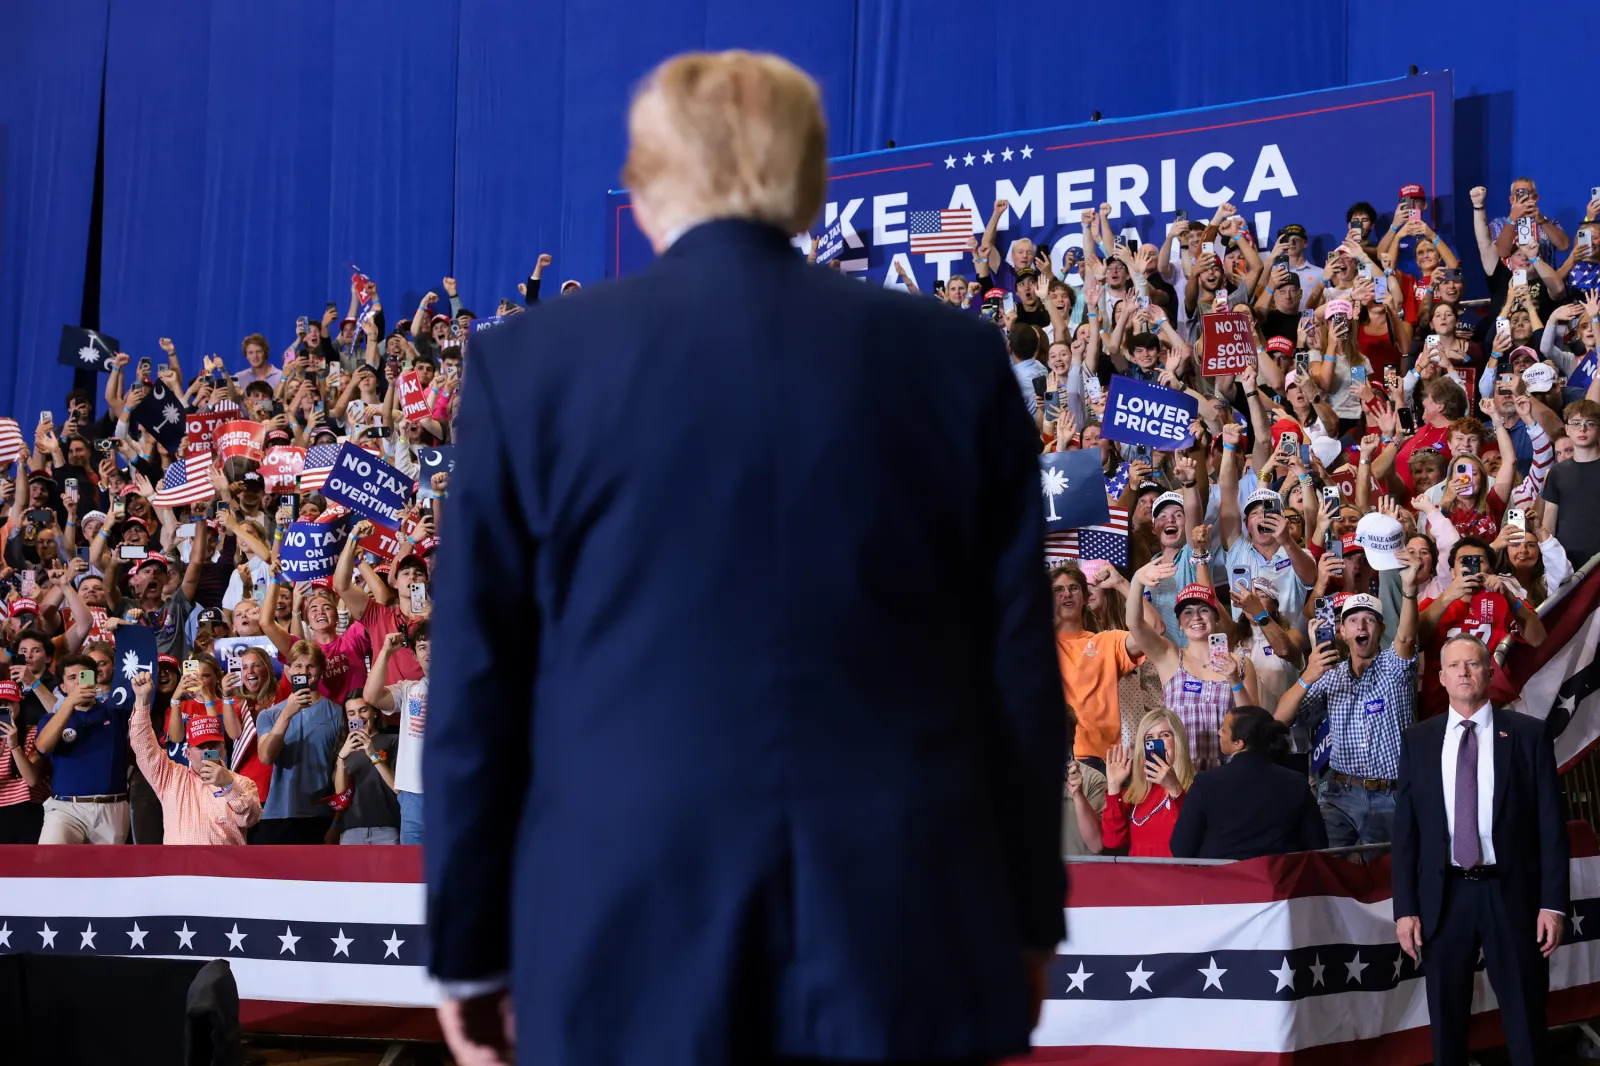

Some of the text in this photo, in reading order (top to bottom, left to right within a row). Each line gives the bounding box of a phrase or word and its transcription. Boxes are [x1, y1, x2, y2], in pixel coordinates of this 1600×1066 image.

[946, 143, 1299, 235] AMERICA
[828, 222, 842, 239] TAX
[1215, 320, 1249, 334] NO TAX
[1233, 333, 1243, 341] ON
[1217, 342, 1254, 357] SOCIAL
[1524, 371, 1545, 379] TRUMP
[1116, 393, 1190, 425] LOWER
[1113, 410, 1186, 441] PRICES
[342, 453, 408, 500] NO TAX
[363, 482, 380, 496] ON
[330, 478, 399, 522] OVERTIME
[284, 523, 348, 547] NO TAX
[1367, 534, 1384, 543] MAKE
[1370, 542, 1389, 551] GREAT
[305, 549, 324, 558] ON
[1189, 585, 1212, 595] AMERICA
[1194, 592, 1209, 600] AGAIN
[327, 653, 348, 666] MEN
[190, 724, 205, 732] RIGHT
[191, 718, 207, 726] TRUMP
